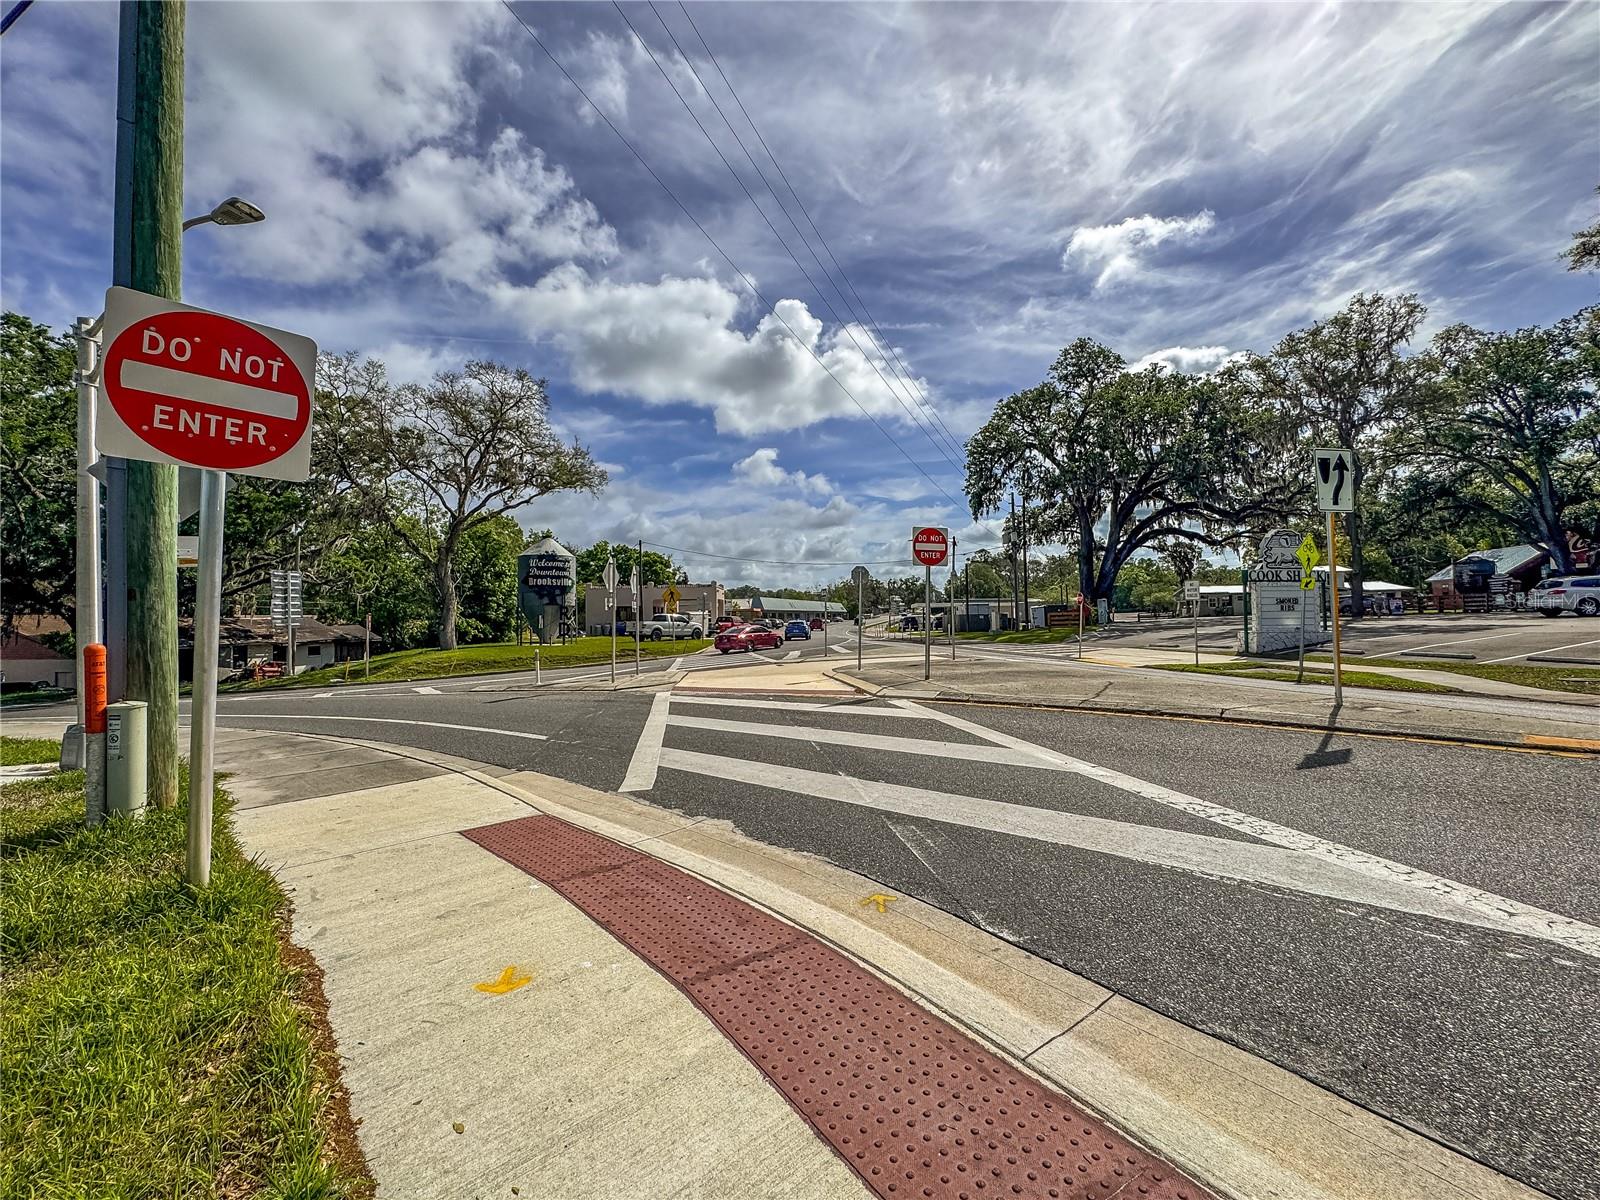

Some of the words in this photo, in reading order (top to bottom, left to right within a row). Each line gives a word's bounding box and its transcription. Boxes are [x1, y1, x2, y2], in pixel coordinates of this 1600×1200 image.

[142, 328, 193, 362] DO
[219, 348, 284, 383] NOT
[152, 403, 267, 446] ENTER
[930, 534, 943, 542] NOT
[920, 551, 941, 559] ENTER
[528, 558, 564, 567] Welcome
[529, 567, 570, 577] Downtown
[1248, 570, 1283, 582] COOK
[528, 577, 572, 586] Brooksville
[1280, 604, 1295, 612] RIBS
